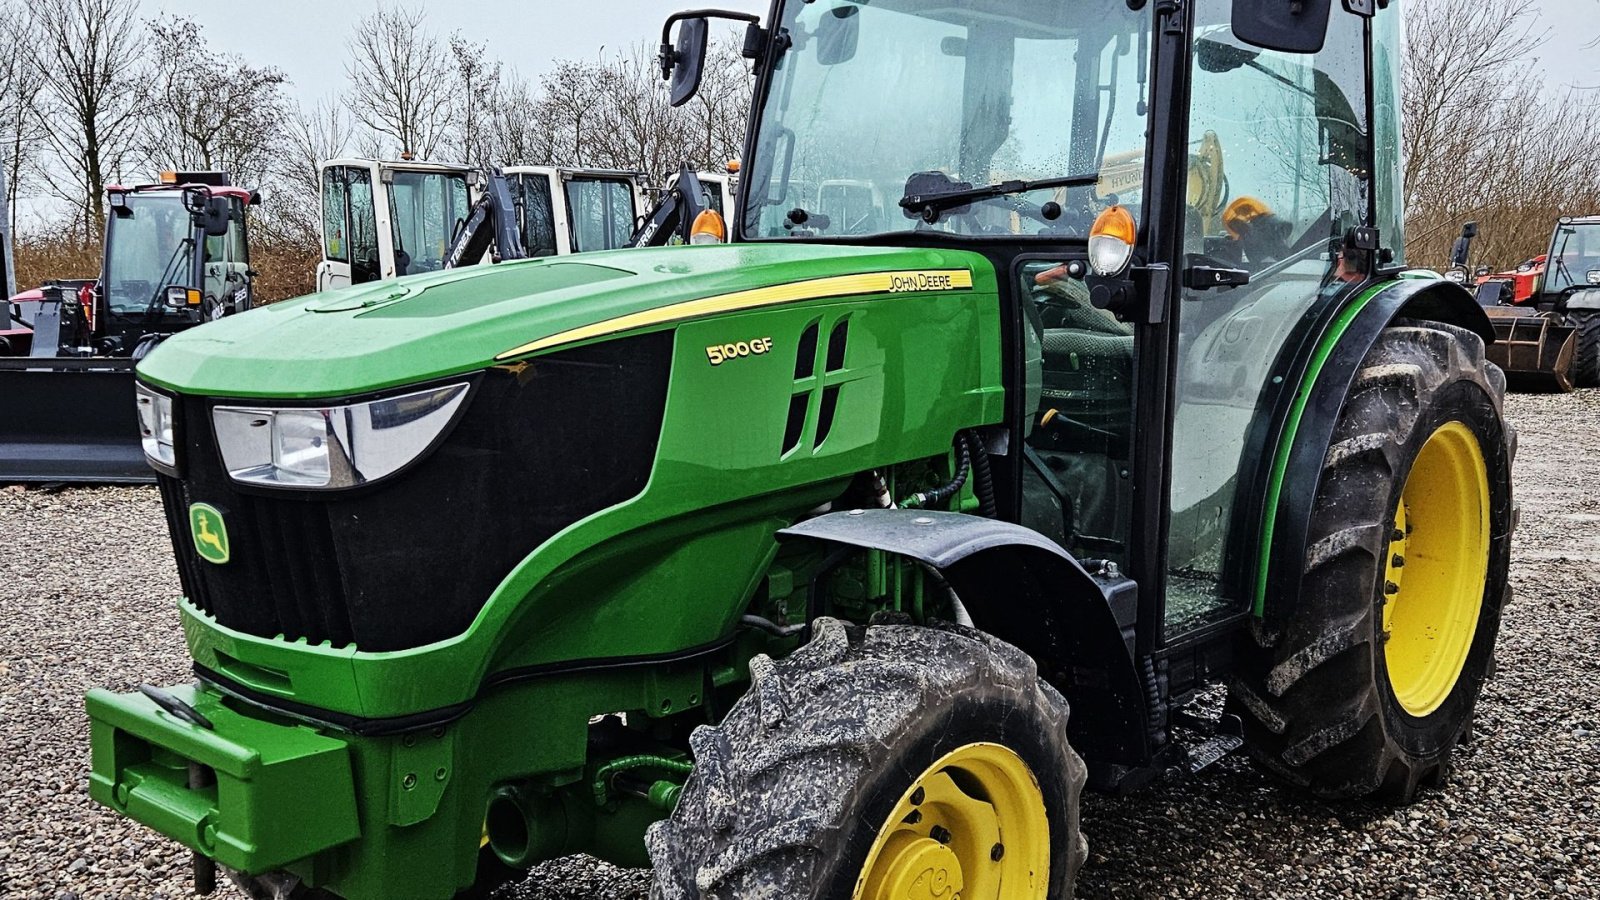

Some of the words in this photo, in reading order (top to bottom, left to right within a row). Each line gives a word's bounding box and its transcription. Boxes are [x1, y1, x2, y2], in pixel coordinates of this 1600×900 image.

[1111, 168, 1141, 188] HYUN
[450, 225, 471, 265] TEREX
[635, 218, 659, 248] EREX
[889, 275, 917, 291] JOHN
[918, 274, 952, 288] DEERE
